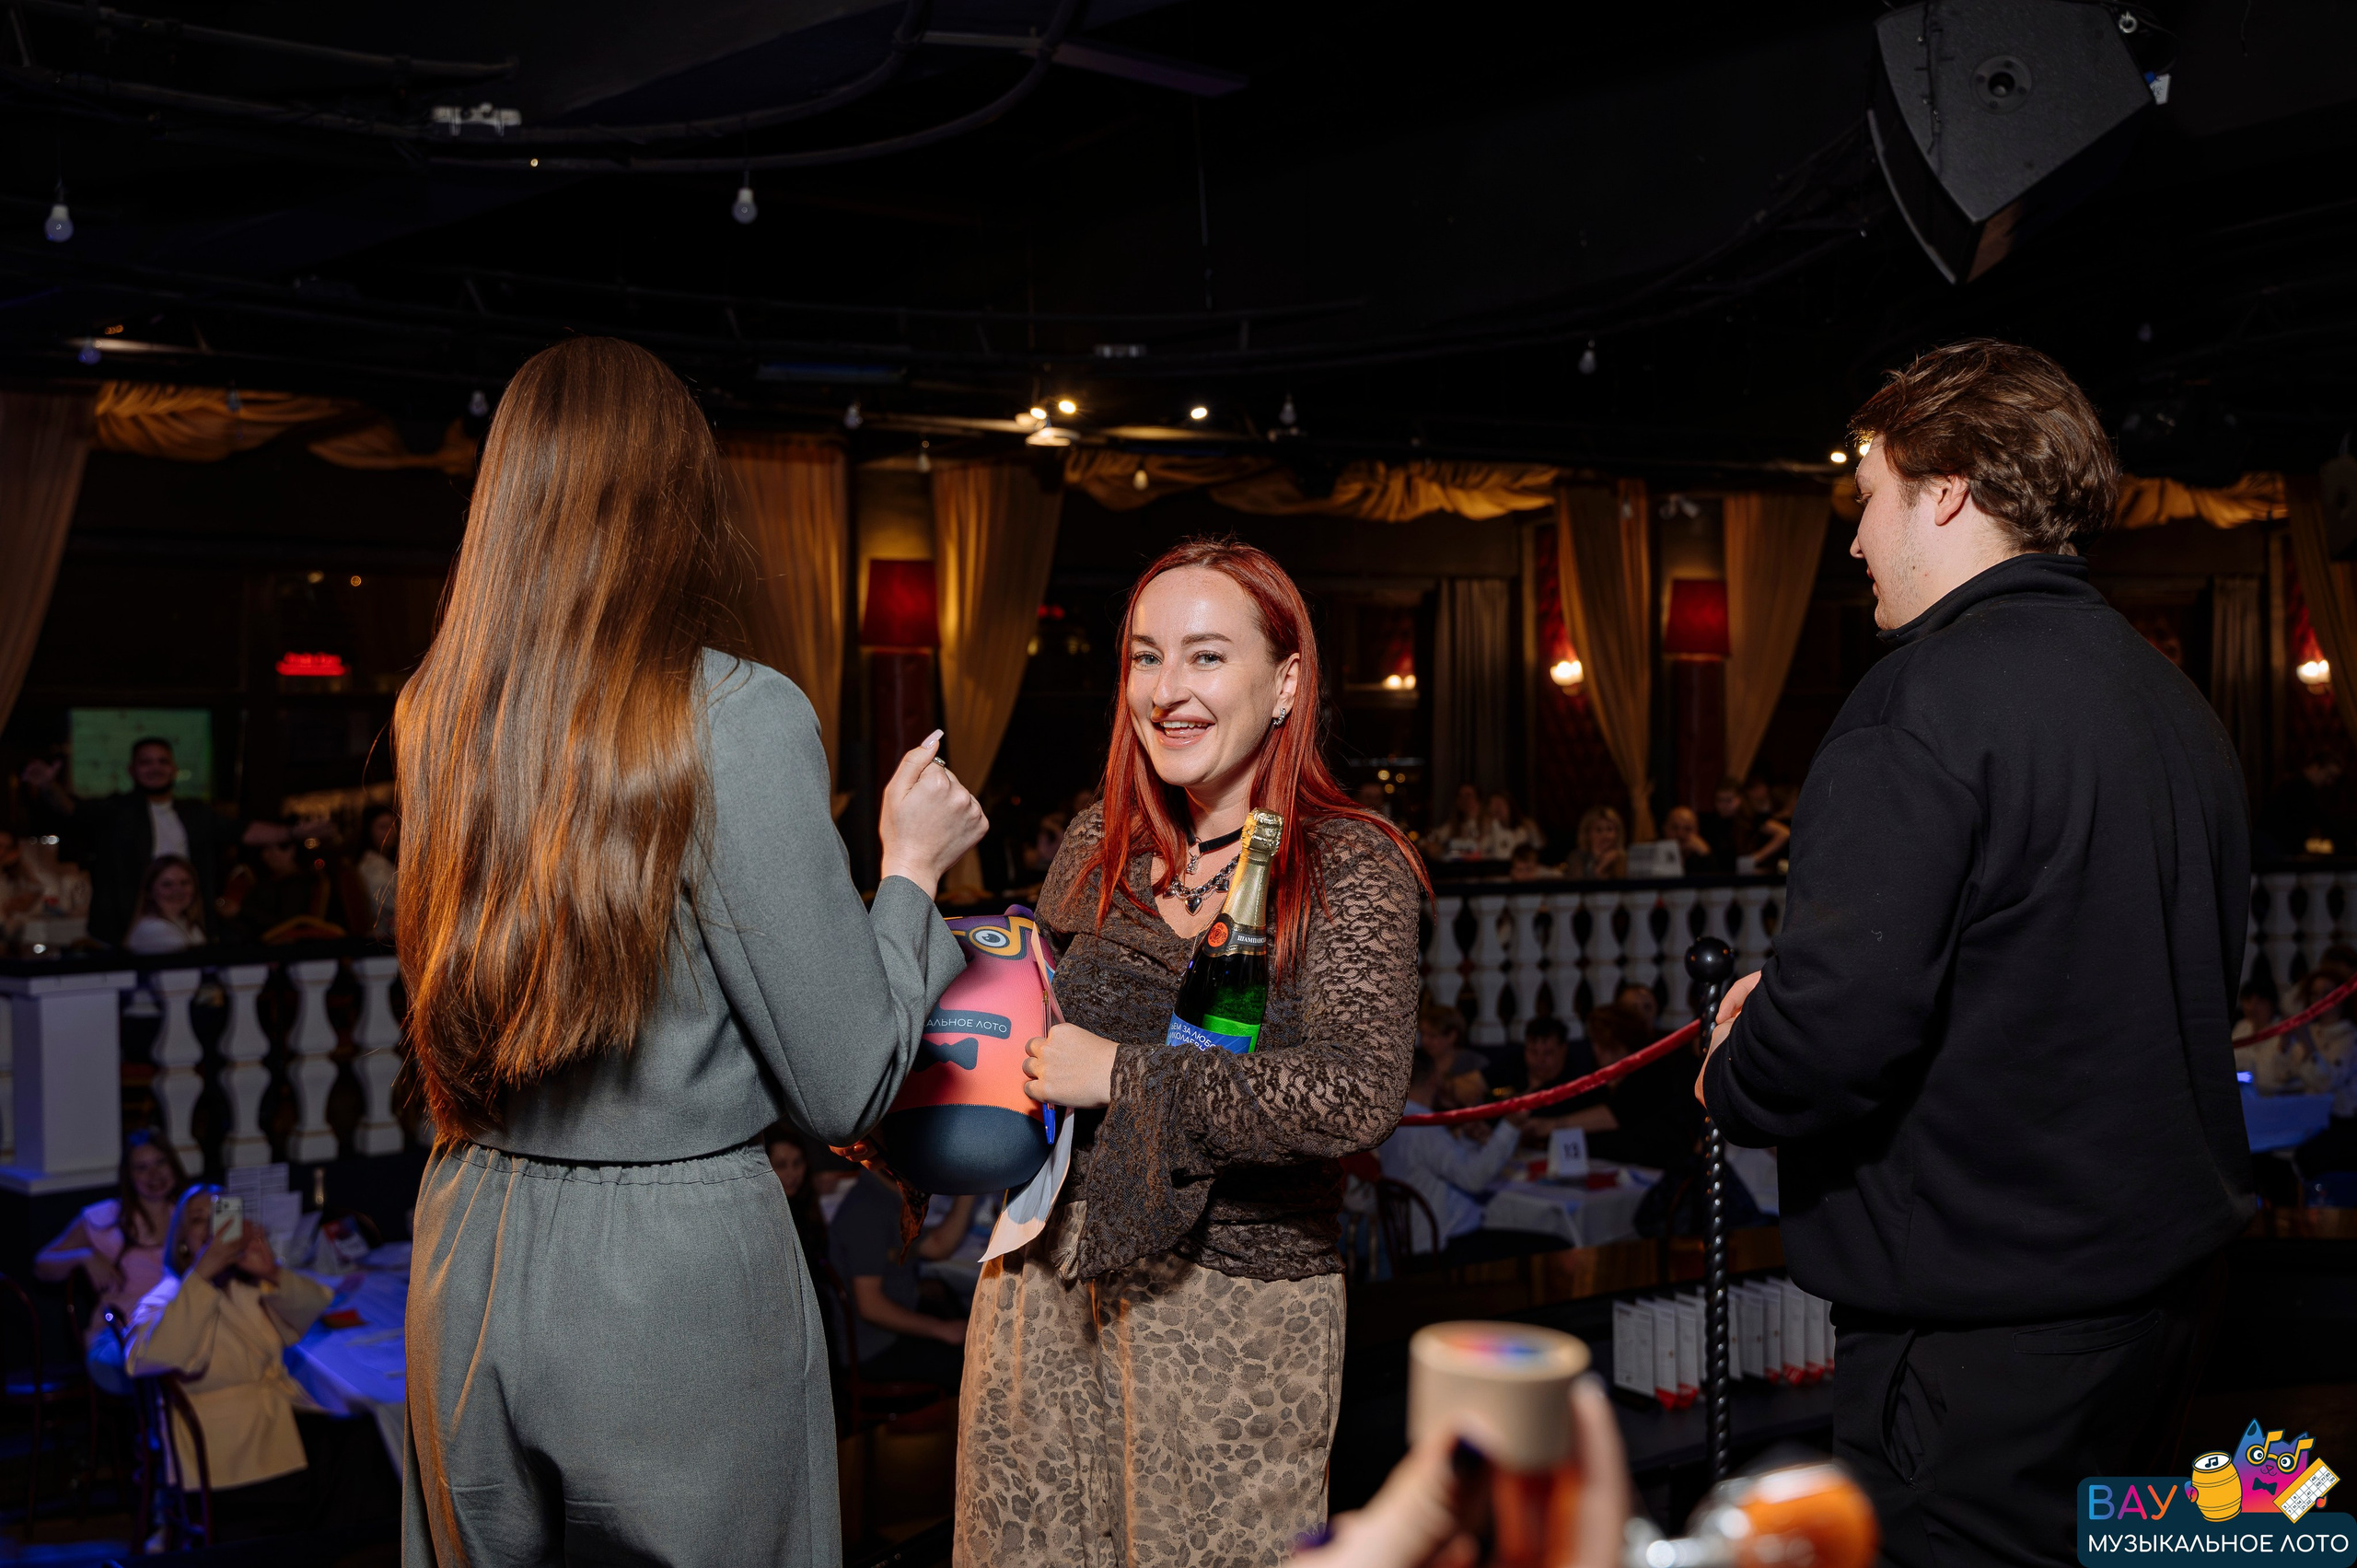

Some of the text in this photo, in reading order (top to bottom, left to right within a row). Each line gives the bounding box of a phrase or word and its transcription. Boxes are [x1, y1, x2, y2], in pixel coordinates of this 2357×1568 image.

[924, 1018, 1008, 1033] АЛЬНОЕ ЛОТО
[1182, 1025, 1191, 1036] ЗА
